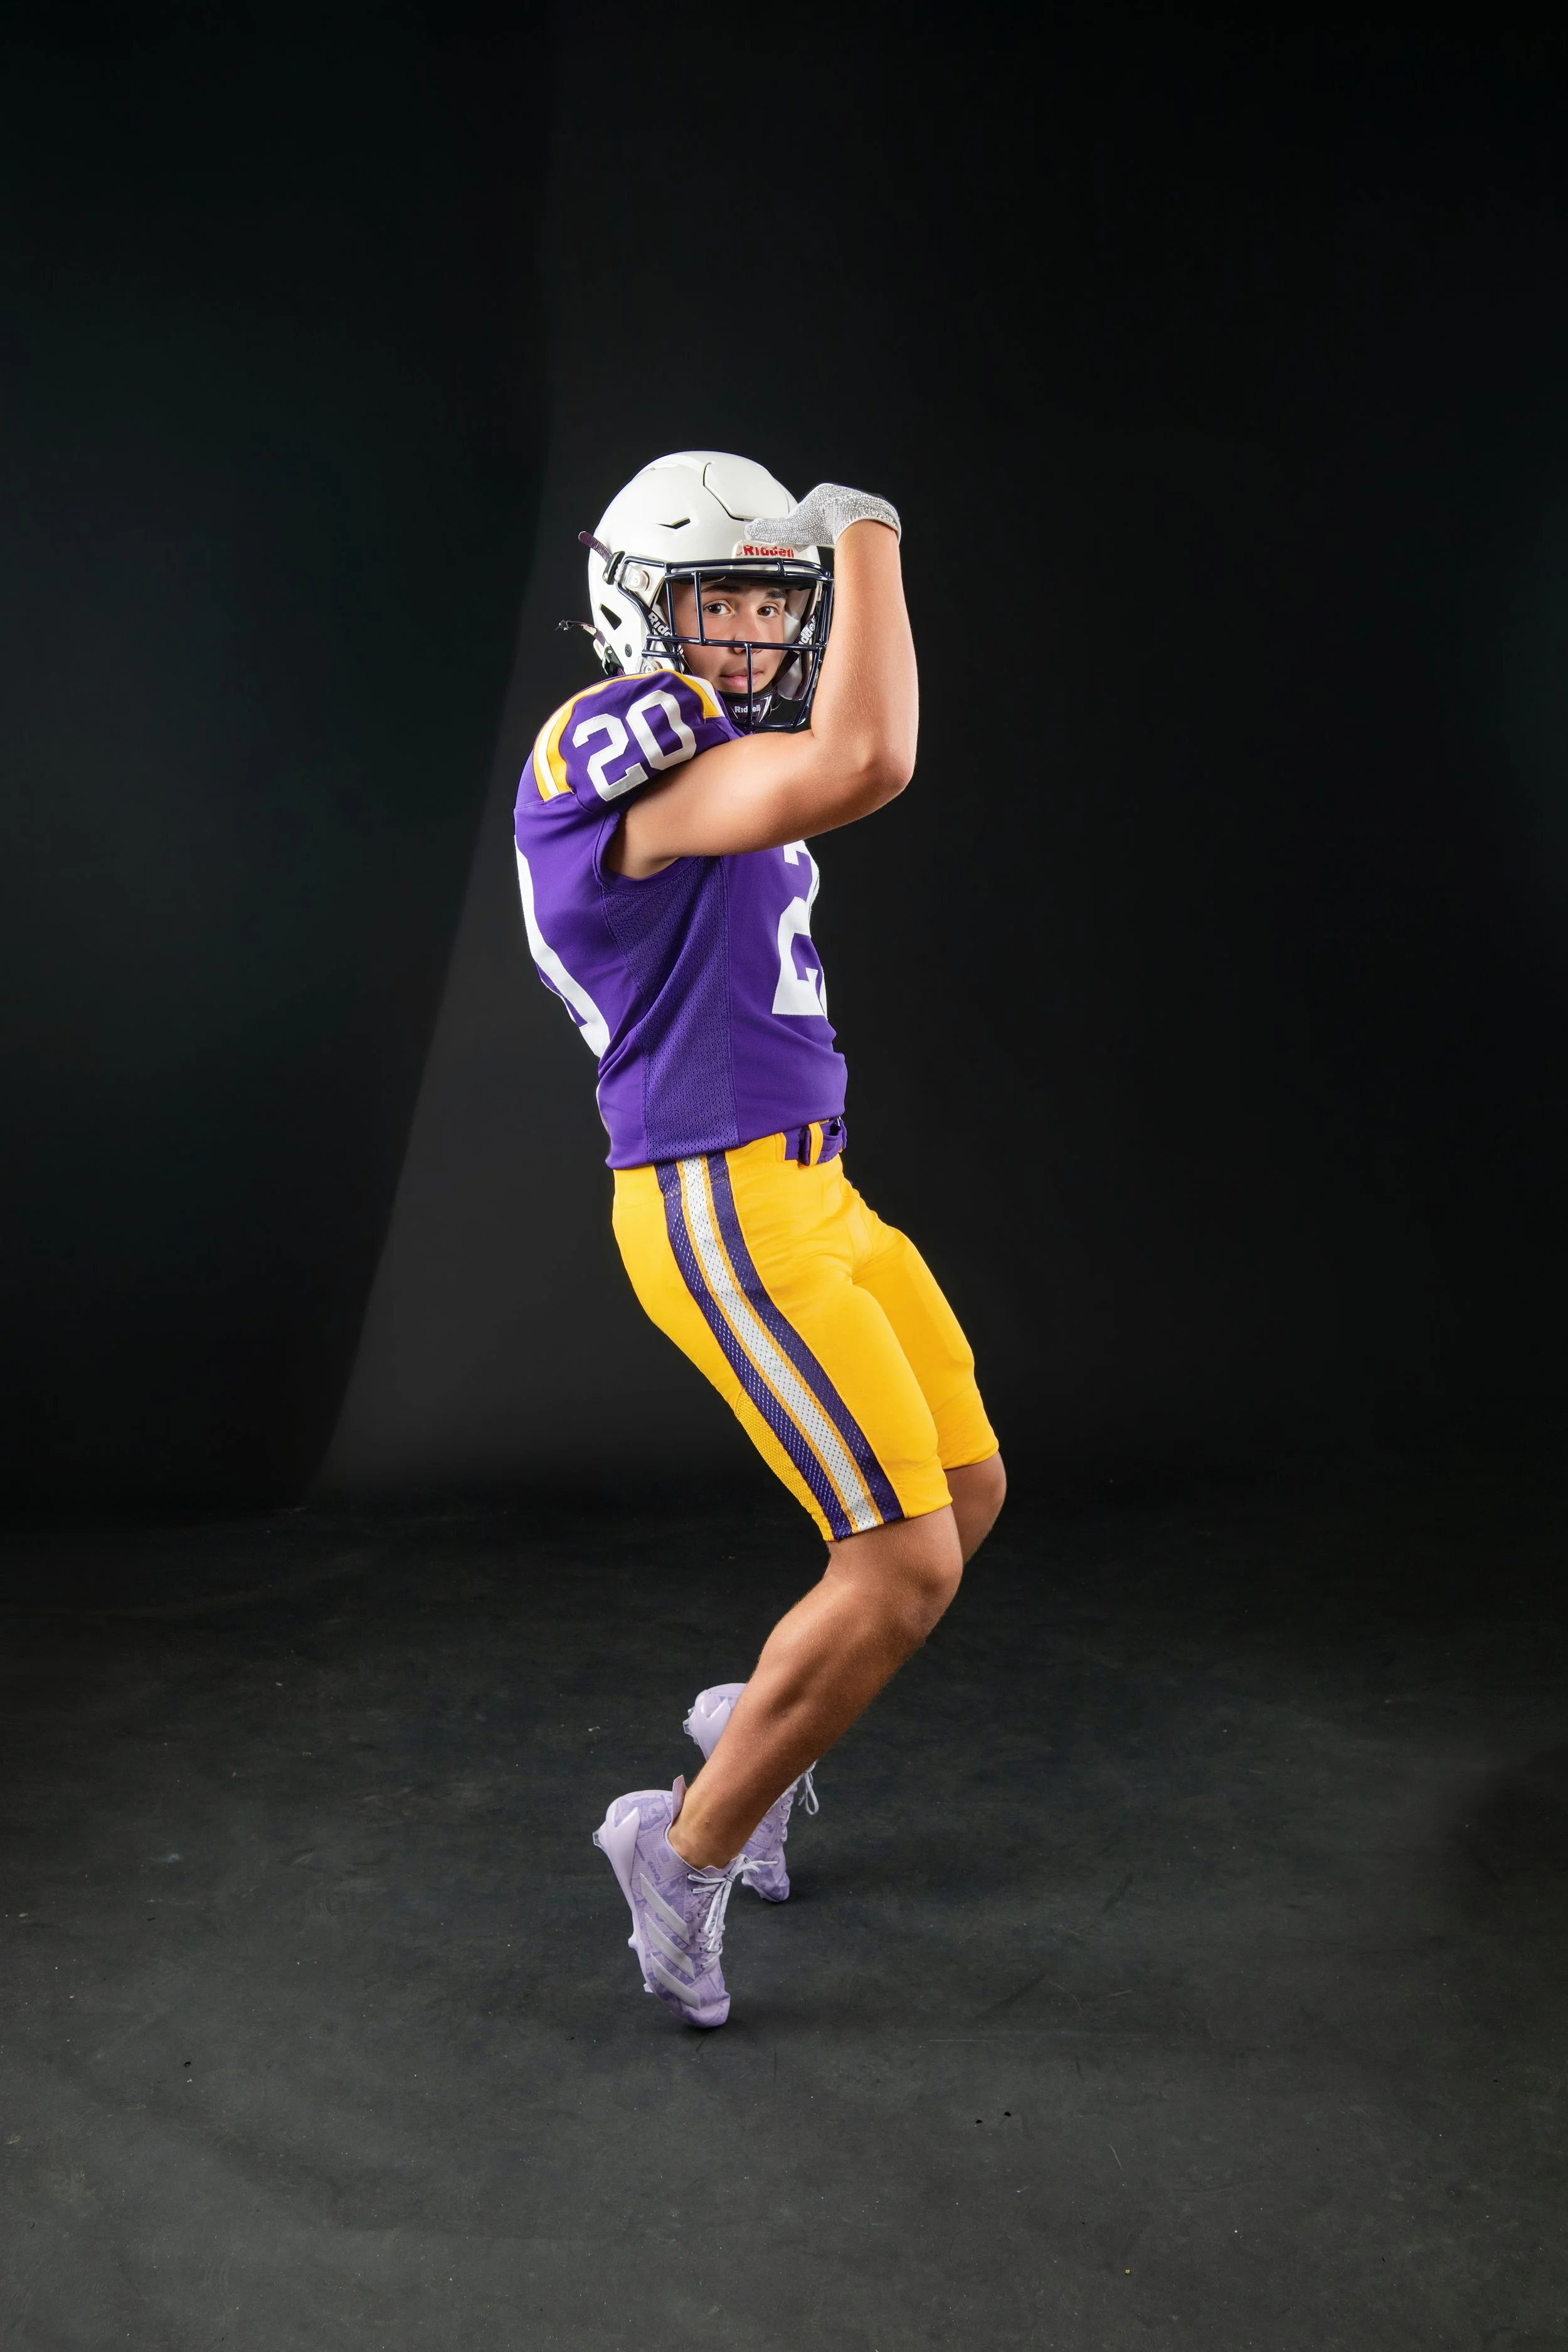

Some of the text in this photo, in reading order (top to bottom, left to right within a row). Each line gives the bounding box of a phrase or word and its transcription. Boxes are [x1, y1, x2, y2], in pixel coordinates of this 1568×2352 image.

[572, 689, 697, 802] 20
[734, 704, 761, 713] Ridell
[771, 840, 828, 1020] 2
